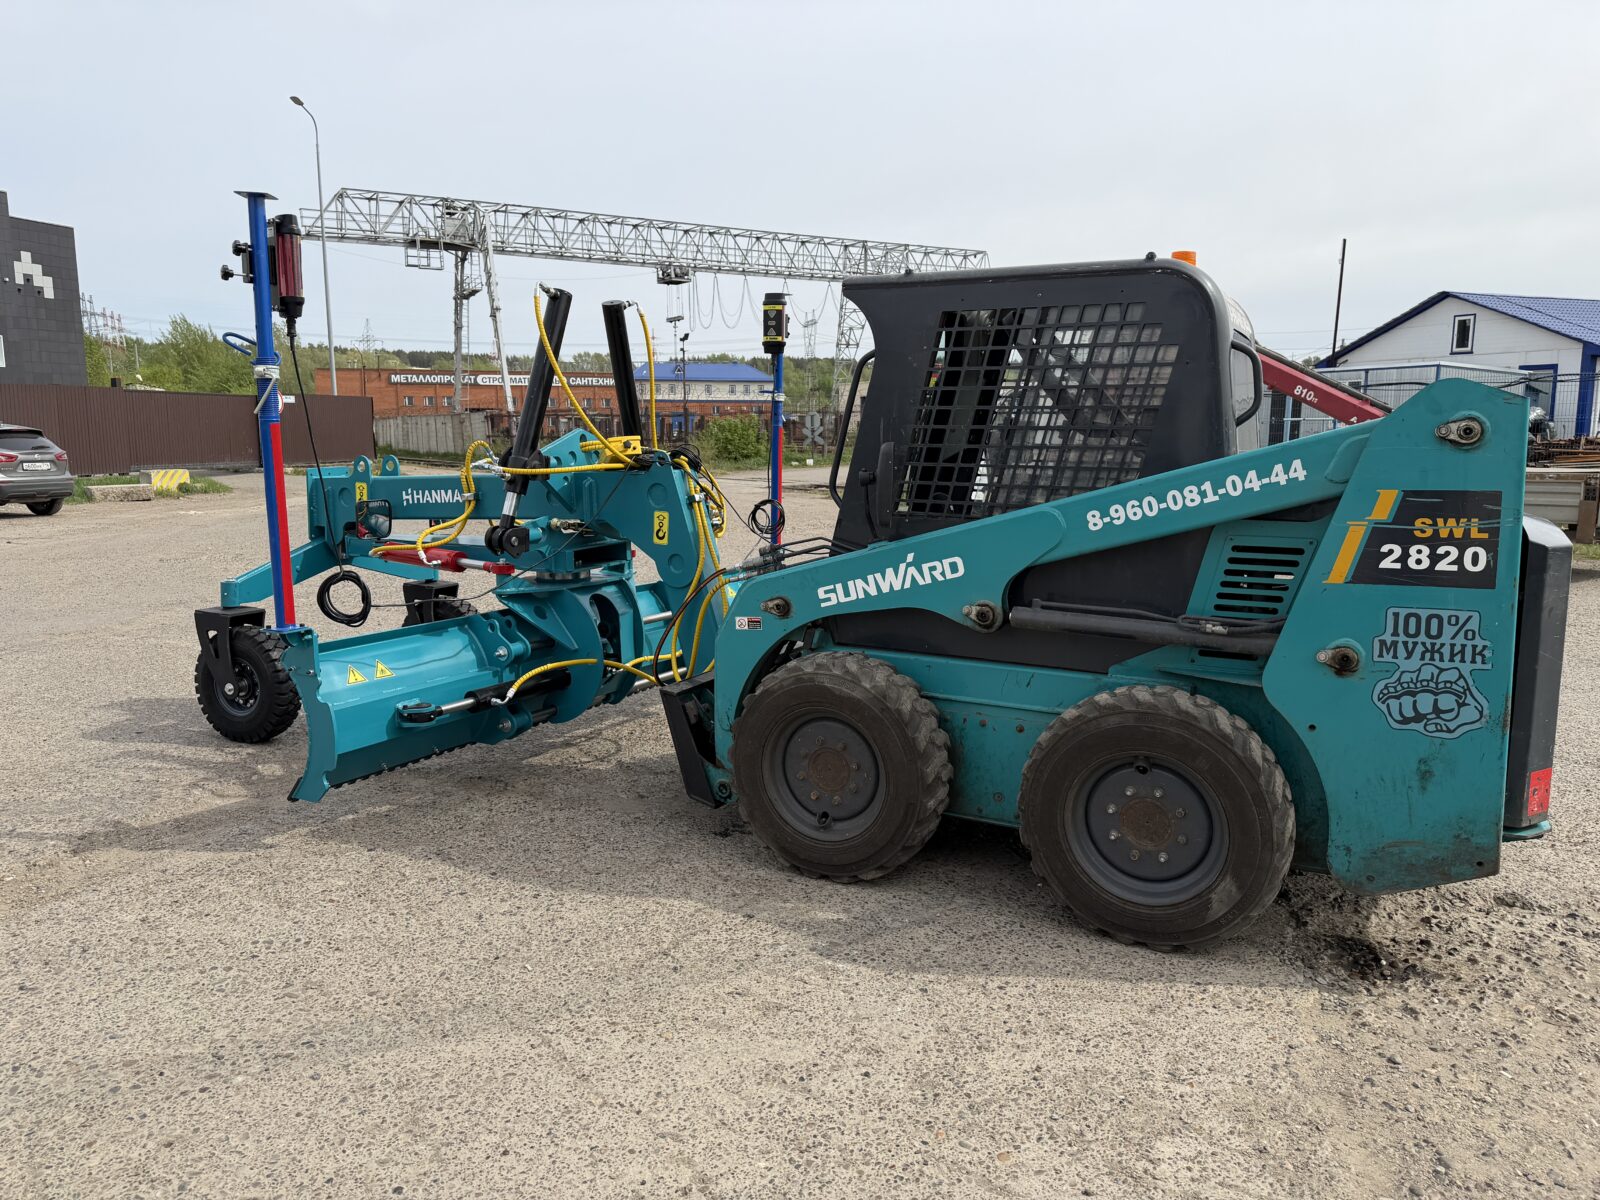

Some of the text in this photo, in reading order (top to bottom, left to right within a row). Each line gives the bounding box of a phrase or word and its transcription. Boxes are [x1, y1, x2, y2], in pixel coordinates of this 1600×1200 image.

[1294, 384, 1314, 401] 810
[1086, 459, 1307, 531] 8-960-081-04-44
[1413, 517, 1489, 539] SWL
[1378, 543, 1487, 572] 2820
[817, 552, 965, 607] SUNWARD
[1390, 611, 1476, 641] 100%
[1377, 639, 1489, 665] МУЖИК
